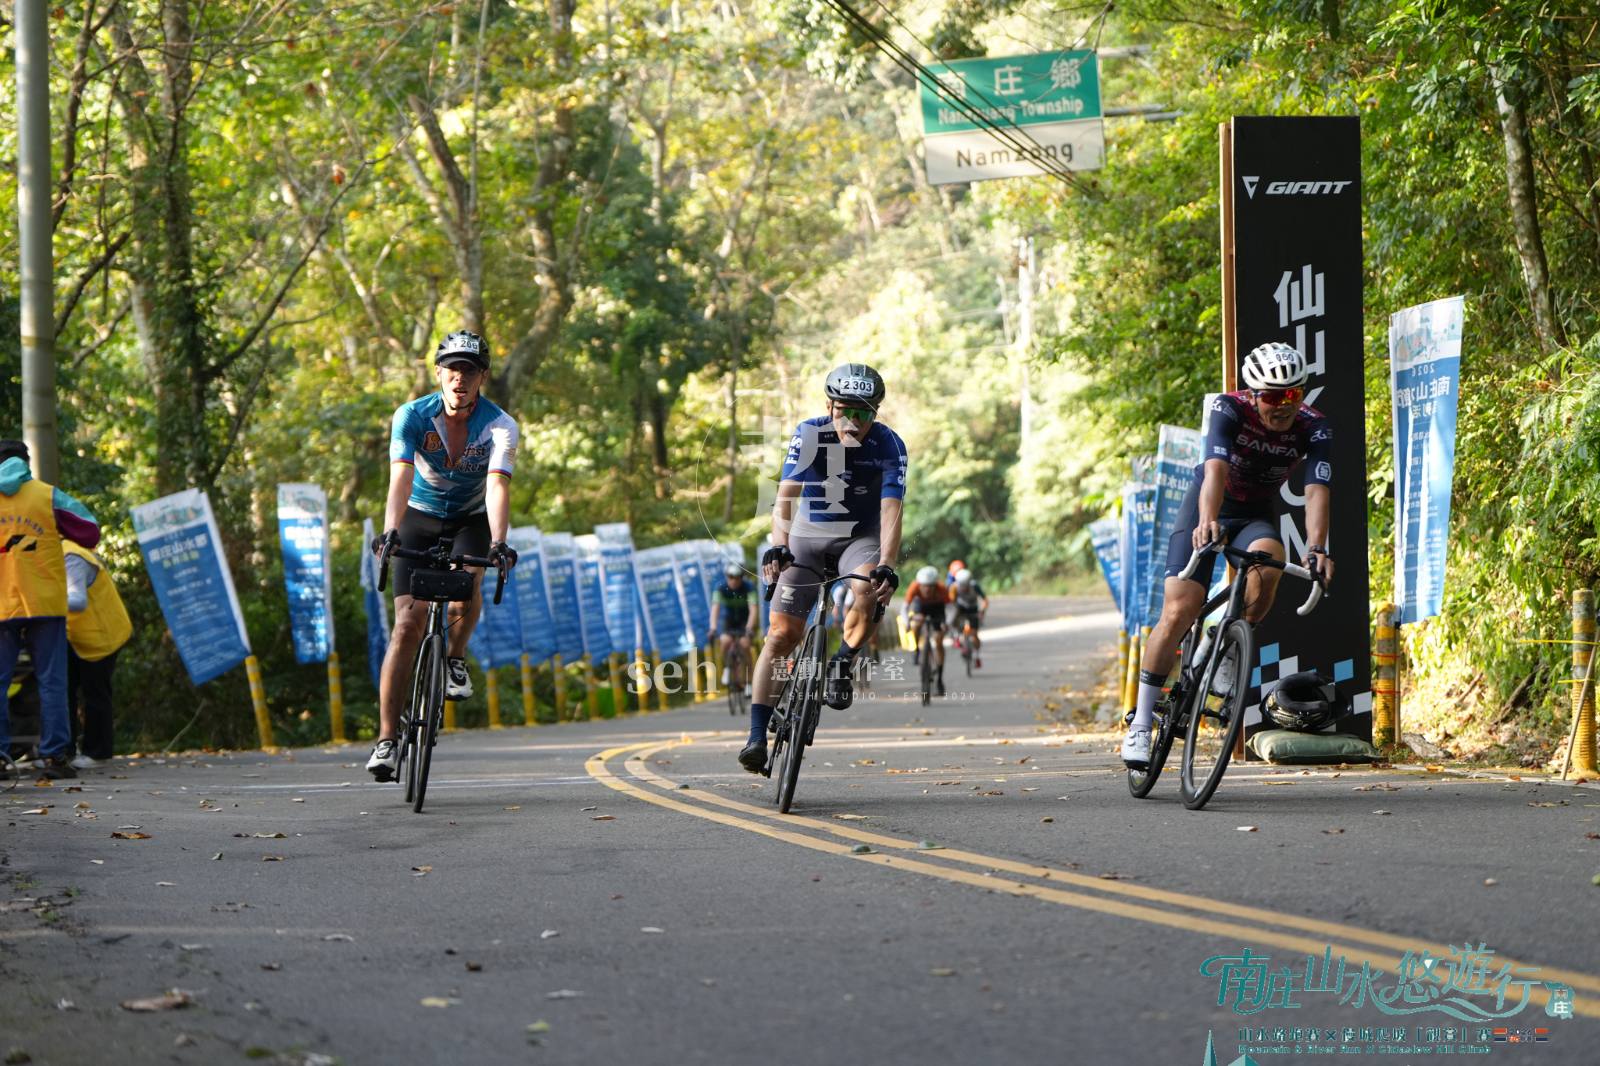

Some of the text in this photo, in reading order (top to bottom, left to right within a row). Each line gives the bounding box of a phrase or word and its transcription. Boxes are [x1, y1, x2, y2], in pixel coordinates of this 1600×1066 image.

[1020, 96, 1083, 118] Township
[1265, 181, 1353, 195] GIANT
[1236, 434, 1299, 457] SANFA
